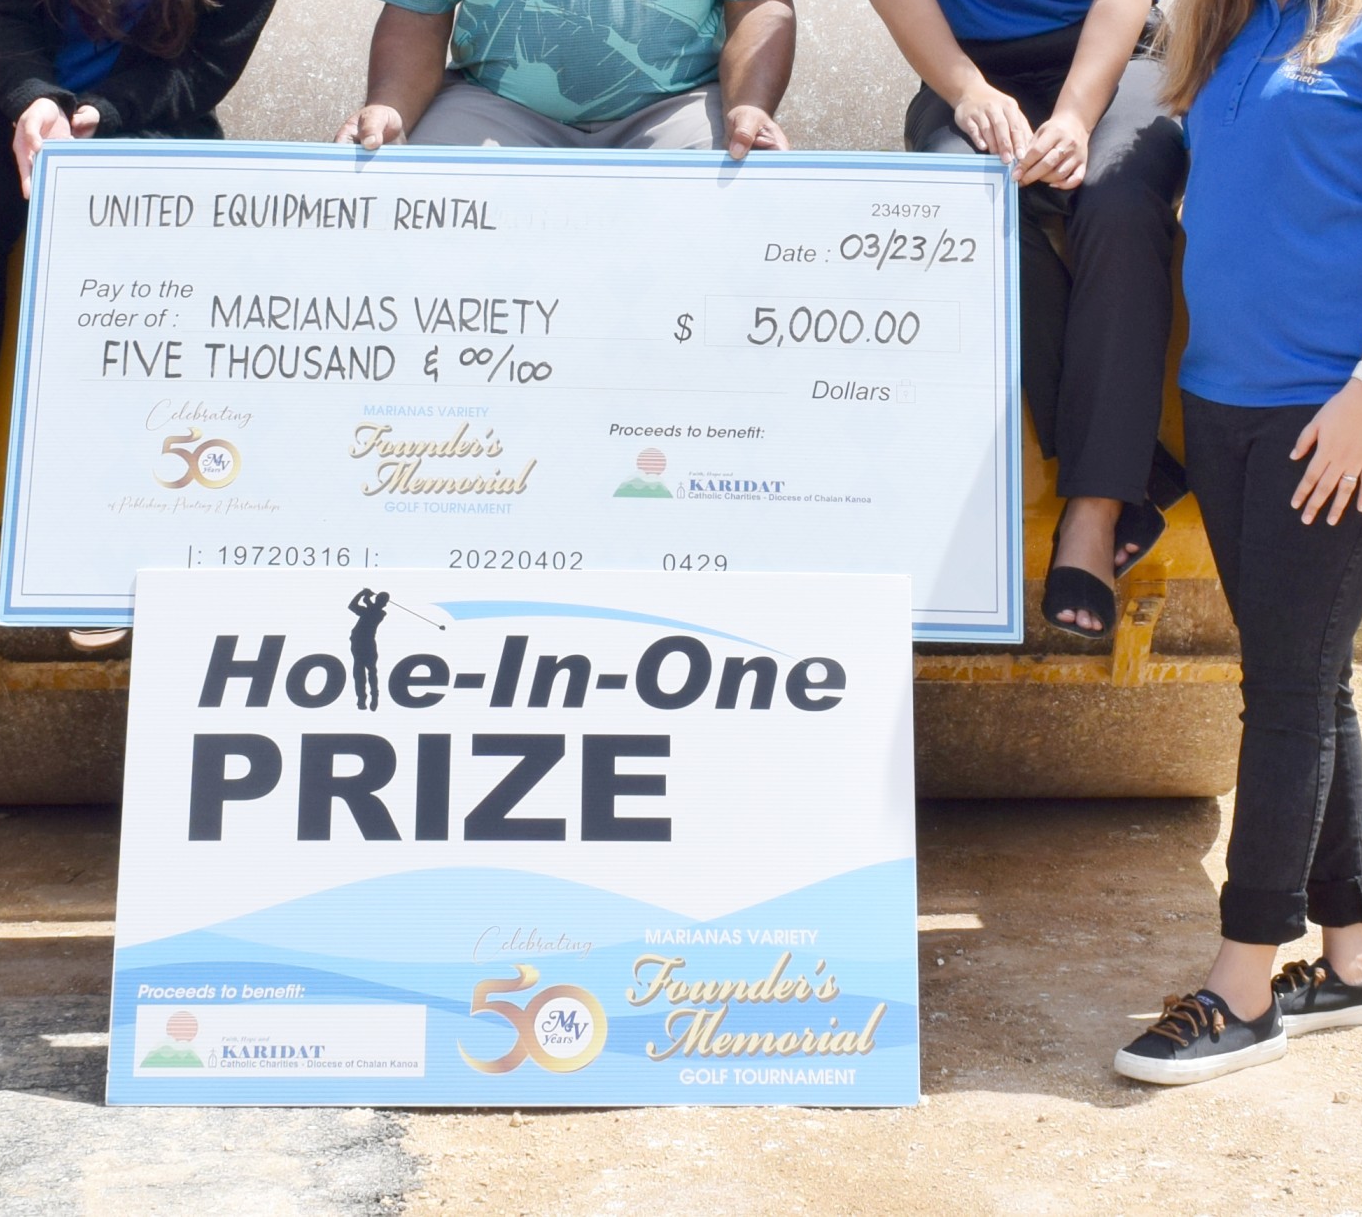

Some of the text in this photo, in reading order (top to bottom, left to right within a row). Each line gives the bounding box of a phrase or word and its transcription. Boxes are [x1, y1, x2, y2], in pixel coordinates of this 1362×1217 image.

[88, 194, 497, 231] UNITED EQUIPMENT RENTAL
[870, 202, 941, 219] 2349797
[764, 243, 818, 263] Date
[839, 228, 977, 272] 03/23/22
[80, 279, 194, 301] Pay to the
[77, 309, 139, 328] order
[144, 309, 169, 328] of
[210, 294, 559, 335] MARIANAS VARIETY
[746, 305, 921, 347] 5,000.00
[674, 313, 694, 344] $
[102, 340, 183, 379] FIVE
[205, 342, 396, 382] THOUSAND
[423, 345, 439, 382] &
[811, 380, 891, 402] Dollars
[145, 398, 254, 431] Celebrating
[363, 405, 489, 418] MARIANAS VARIETY
[348, 420, 503, 459] Founder's
[609, 423, 766, 440] Proceeds to benefit:
[152, 426, 243, 489] 50
[361, 457, 537, 496] Memorial
[689, 479, 785, 493] KARIDAT
[384, 501, 513, 514] GOLF TOURNAMENT
[688, 492, 722, 500] Catholic
[724, 493, 761, 501] Charities
[769, 493, 802, 502] Diocese
[804, 494, 812, 502] of
[845, 495, 872, 503] Kanoa
[218, 545, 350, 567] 19720316
[449, 549, 583, 570] 20220402
[662, 553, 728, 571] 0429
[188, 733, 672, 842] PRIZE
[473, 925, 594, 964] Celebrating
[645, 929, 818, 945] MARIANAS VARIETY
[625, 950, 841, 1007] Founder's
[137, 984, 306, 1000] Proceeds to benefit:
[457, 963, 608, 1074] 50
[645, 1001, 888, 1062] Memorial
[220, 1060, 257, 1068] Catholic
[259, 1060, 298, 1068] Charities
[307, 1060, 342, 1068] Diocese
[345, 1060, 354, 1068] of
[357, 1060, 387, 1068] Chalan
[390, 1060, 418, 1068] Kanoa
[222, 1045, 325, 1058] KARIDAT
[679, 1069, 856, 1085] GOLF TOURNAMENT
